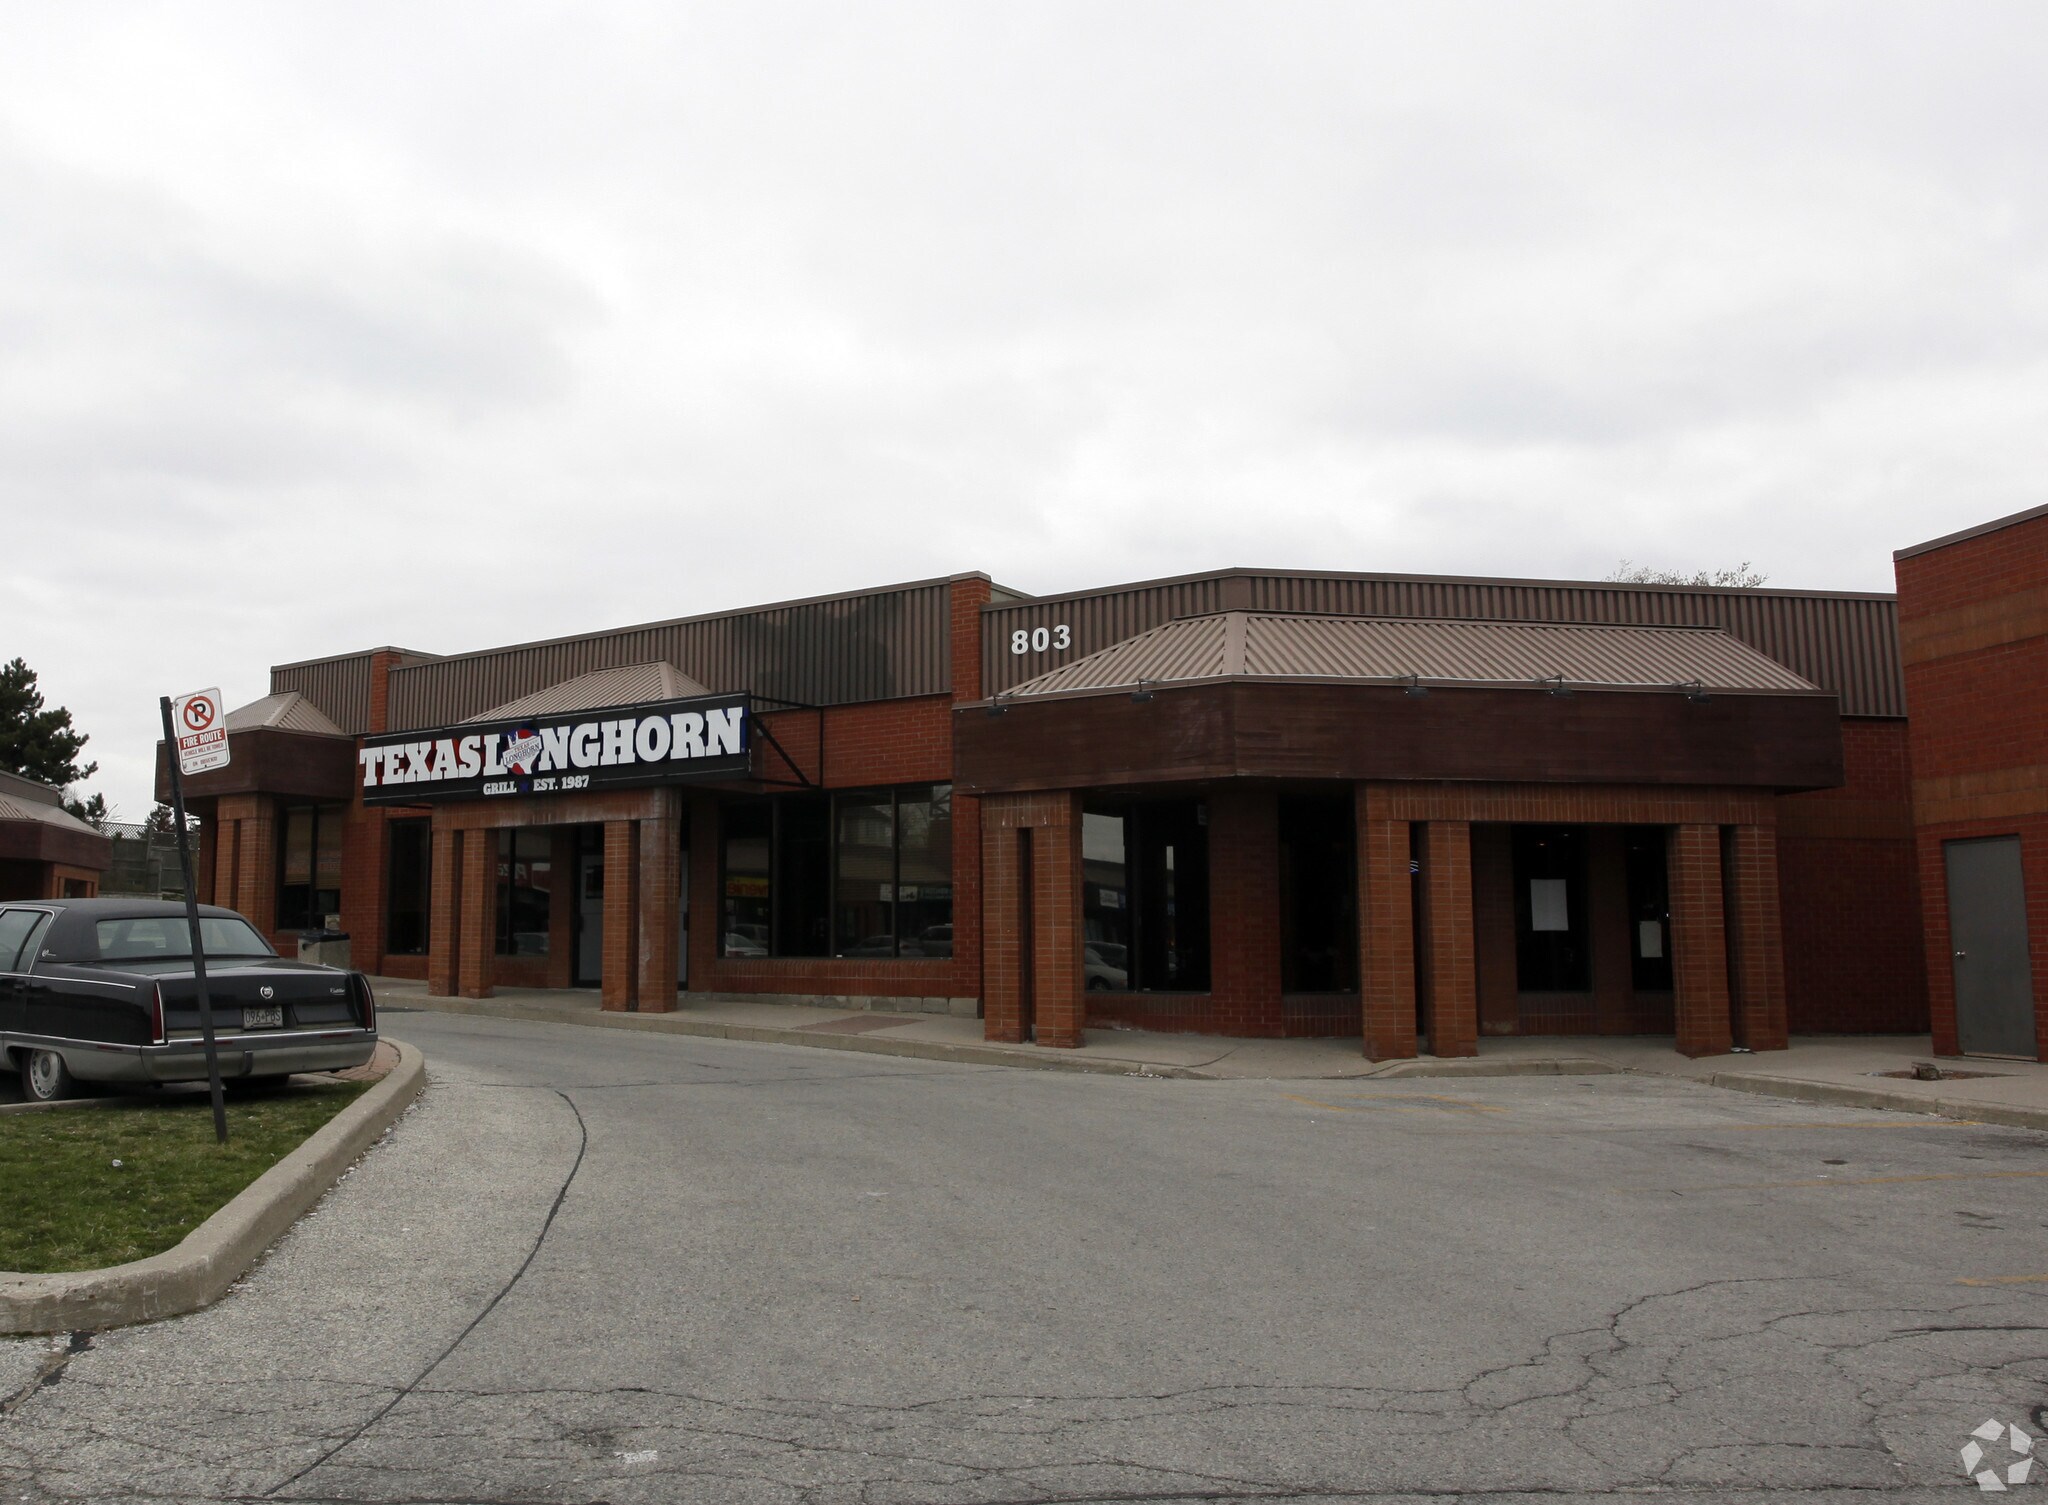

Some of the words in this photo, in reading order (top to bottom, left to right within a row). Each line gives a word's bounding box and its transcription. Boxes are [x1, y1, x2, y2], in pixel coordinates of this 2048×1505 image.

[1011, 624, 1071, 655] 803
[183, 735, 199, 748] FIRE
[200, 730, 223, 744] ROUTE
[359, 735, 482, 787] TEXAS
[483, 707, 744, 777] LNGHORN
[505, 742, 540, 764] LONGHORN
[483, 781, 517, 795] GRILL
[533, 777, 559, 791] EST.
[562, 775, 589, 789] 1987
